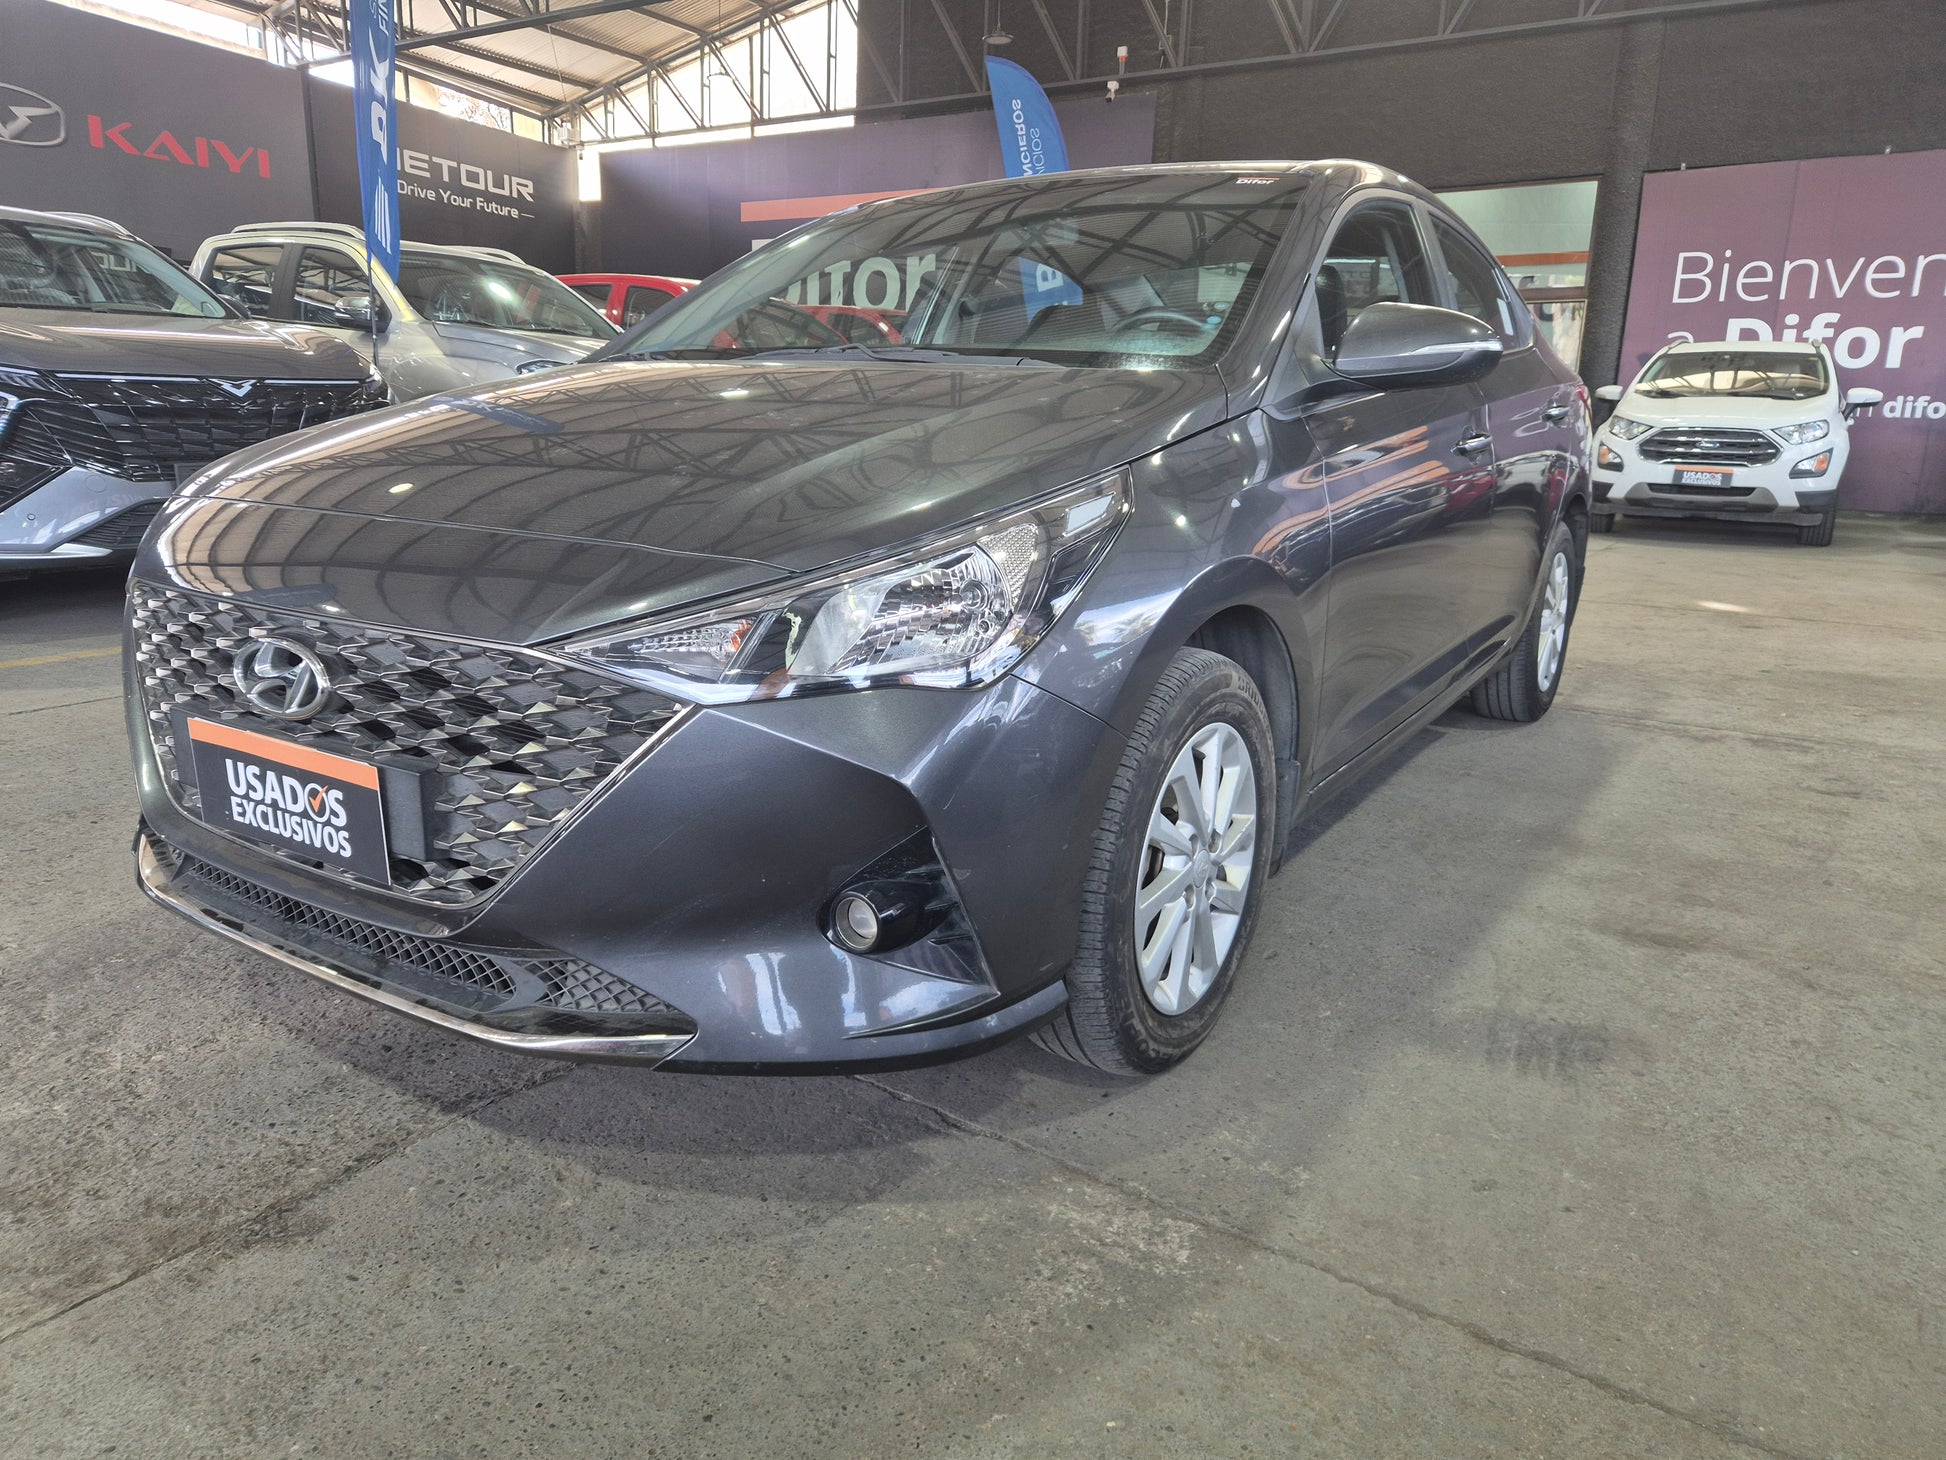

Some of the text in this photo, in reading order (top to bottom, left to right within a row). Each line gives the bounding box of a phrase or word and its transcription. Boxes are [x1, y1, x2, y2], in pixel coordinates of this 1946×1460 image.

[87, 114, 271, 179] KAIYI
[397, 179, 519, 219] Drive Your Future
[1672, 249, 1946, 304] Bienven
[1883, 395, 1946, 419] difo
[1682, 471, 1722, 480] USADOS
[225, 758, 347, 827] USADOS
[230, 796, 352, 858] EXCLUSIVOS
